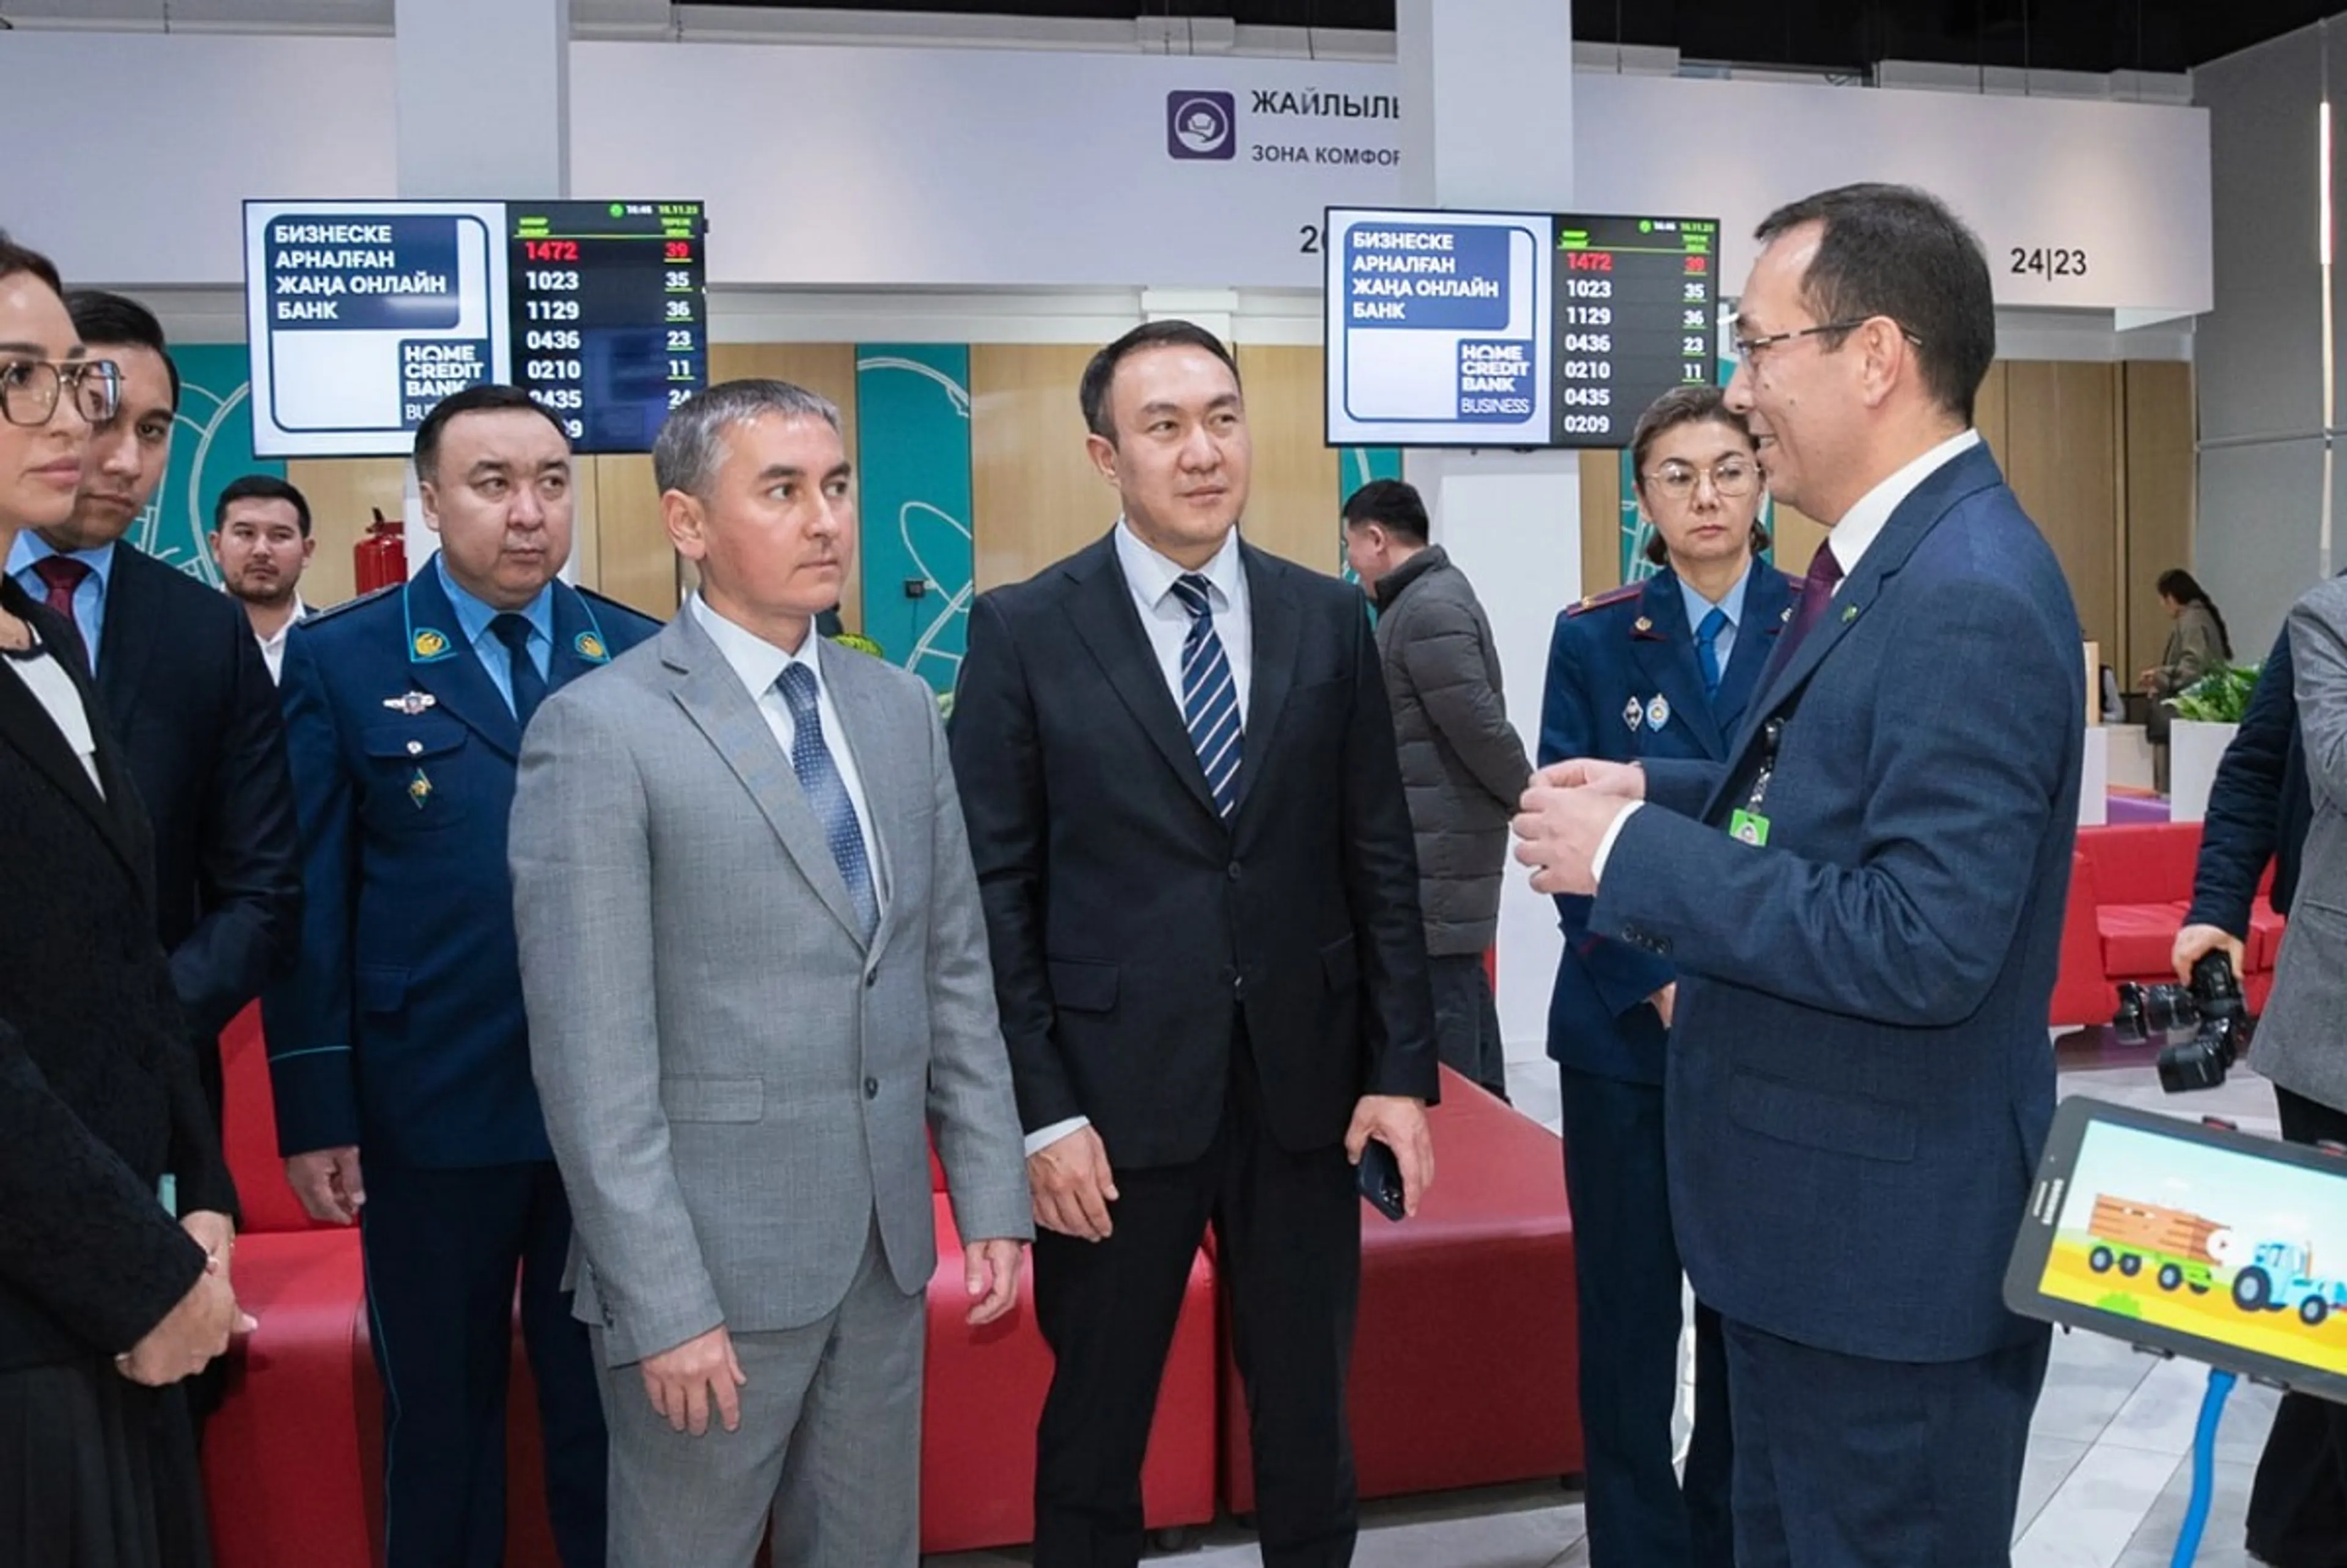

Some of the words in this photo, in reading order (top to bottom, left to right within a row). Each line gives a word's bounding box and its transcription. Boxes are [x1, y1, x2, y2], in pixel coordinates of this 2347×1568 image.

[1252, 144, 1309, 163] ЗОНА
[275, 224, 392, 243] БИЗНЕСКЕ
[1300, 224, 1324, 253] 2
[1353, 232, 1454, 251] БИЗНЕСКЕ
[275, 250, 395, 268] АРНАЛҒАН
[526, 241, 578, 260] 1472
[666, 242, 689, 259] 39
[1352, 255, 1455, 274] АРНАЛҒАН
[1567, 252, 1612, 271] 1472
[1686, 256, 1705, 272] 39
[276, 276, 347, 296] ЖАҢА
[350, 271, 447, 294] ОНЛАЙН
[526, 271, 579, 290] 1023
[666, 271, 689, 288] 35
[1352, 278, 1414, 298] ЖАҢА
[1416, 277, 1499, 298] ОНЛАЙН
[1567, 279, 1612, 298] 1023
[1684, 283, 1705, 299] 35
[277, 301, 338, 320] БАНК
[527, 301, 579, 320] 1129
[666, 301, 690, 318] 36
[1353, 301, 1406, 320] БАНК
[1567, 306, 1611, 325] 1129
[1684, 310, 1705, 326] 36
[526, 330, 581, 350] 0436
[667, 330, 691, 347] 23
[1565, 334, 1611, 352] 0436
[1683, 337, 1703, 352] 23
[405, 345, 476, 361] HOME
[1461, 345, 1523, 361] HOME
[405, 362, 485, 379] CREDIT
[527, 360, 581, 379] 0210
[669, 359, 689, 377] 11
[1461, 361, 1530, 376] CREDIT
[1565, 361, 1611, 379] 0210
[1684, 364, 1701, 380] 11
[406, 380, 467, 396] BANK
[1461, 377, 1516, 392] BANK
[1461, 397, 1530, 414] BUSINESS
[1564, 387, 1611, 406] 0435
[1564, 415, 1610, 433] 0209
